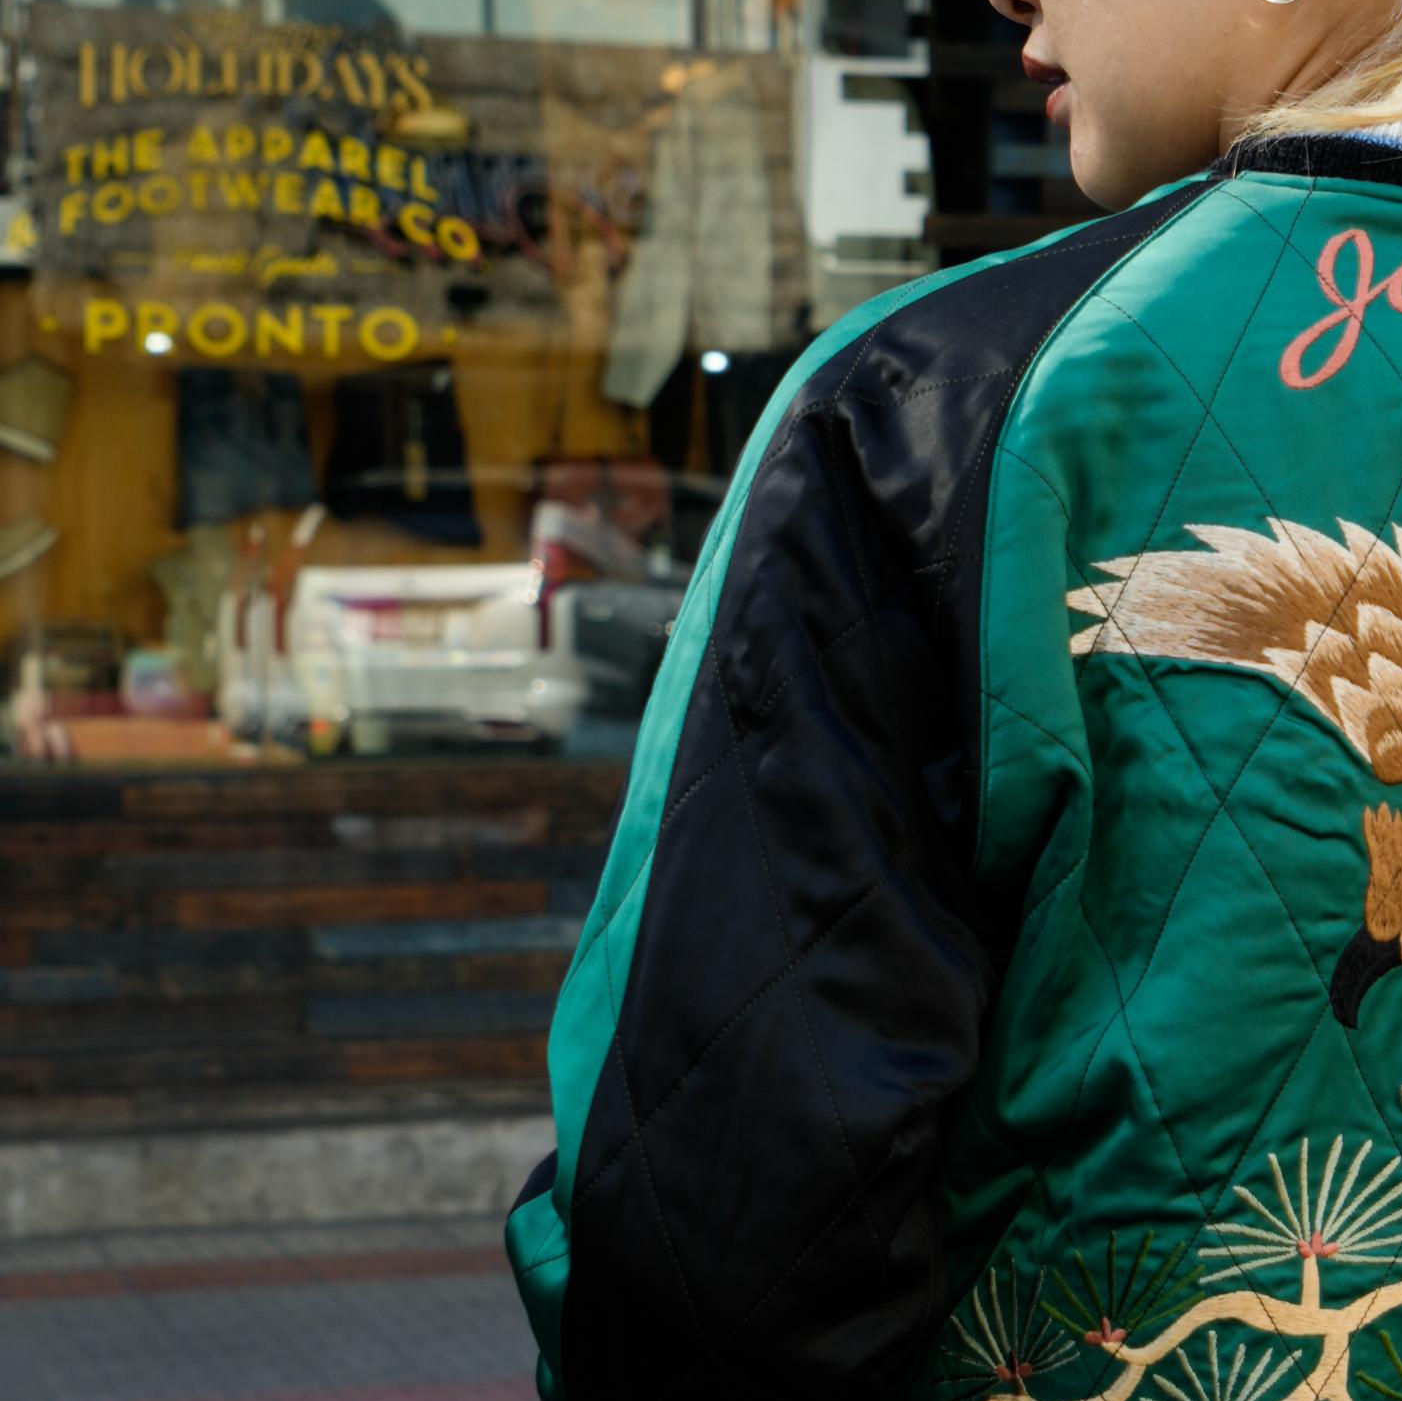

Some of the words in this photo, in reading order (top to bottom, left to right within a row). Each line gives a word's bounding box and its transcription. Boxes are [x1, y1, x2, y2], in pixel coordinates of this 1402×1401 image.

[65, 127, 165, 184] THE
[187, 124, 438, 202] APPAREL
[58, 172, 381, 236] FOOTWEAR
[400, 202, 481, 261] CO
[84, 300, 418, 361] PRONTO
